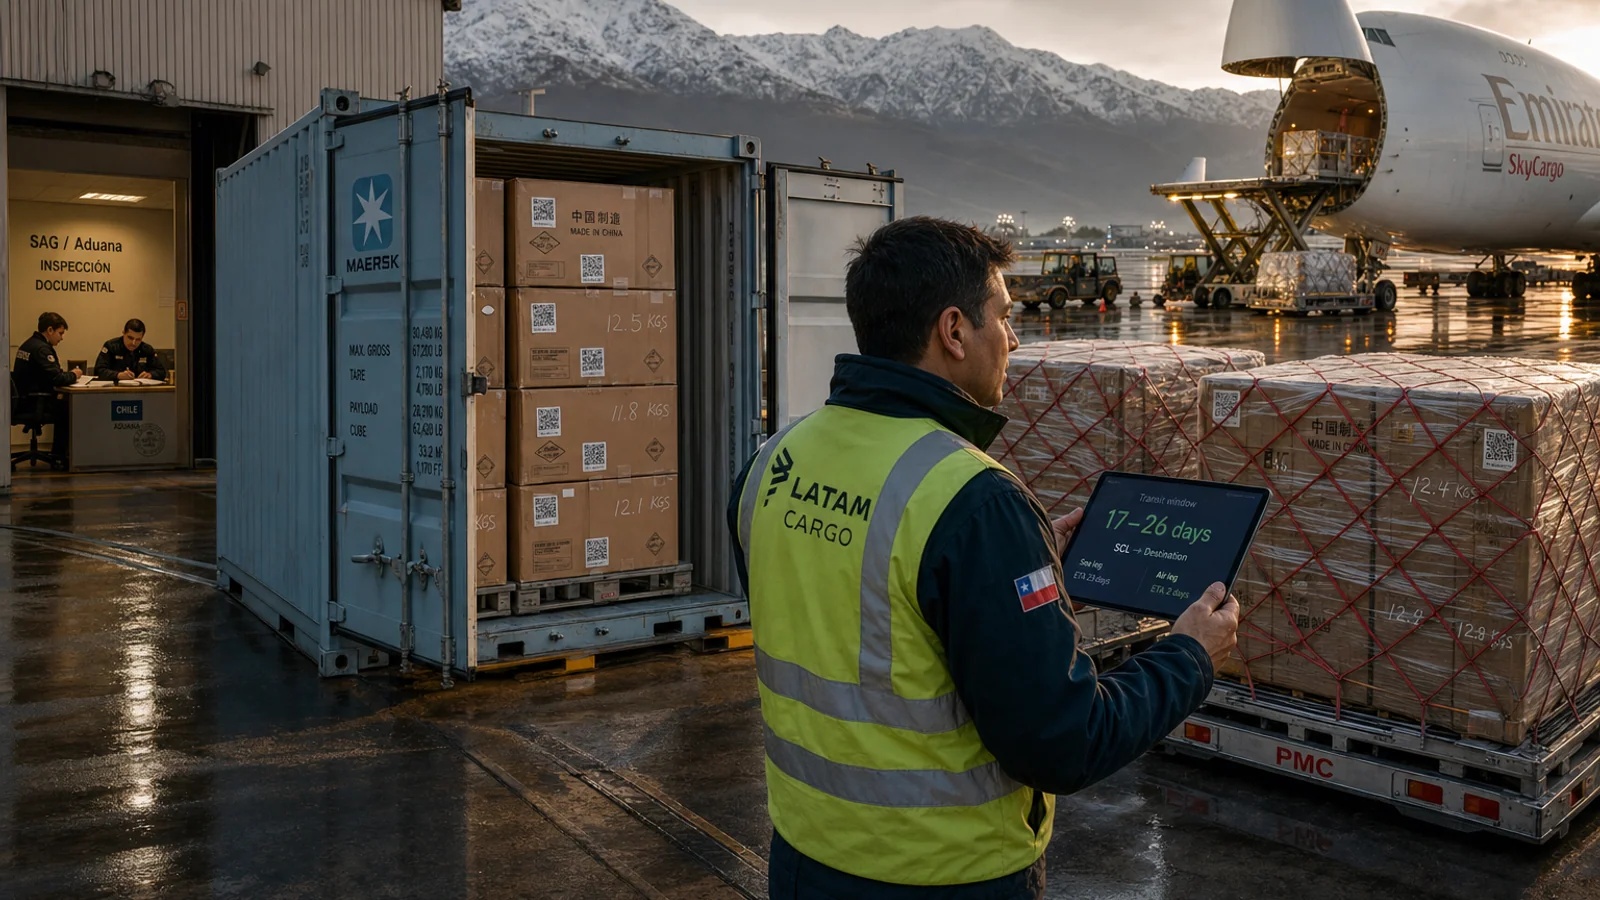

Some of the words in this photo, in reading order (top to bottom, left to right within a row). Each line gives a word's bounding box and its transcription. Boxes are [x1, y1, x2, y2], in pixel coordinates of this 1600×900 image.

[1508, 153, 1564, 182] SkyCargo
[570, 227, 591, 236] MADE
[592, 228, 600, 236] IN
[602, 228, 623, 237] CHINA
[30, 235, 59, 249] SAG
[74, 236, 123, 252] Aduana
[40, 259, 111, 274] INSPECCIÓN
[346, 254, 400, 273] MAERSK
[35, 279, 115, 293] DOCUMENTAL
[607, 313, 642, 333] 12.5
[367, 344, 391, 357] GROSS
[435, 344, 443, 357] LB
[349, 368, 366, 381] TARE
[435, 383, 443, 397] LB
[116, 405, 138, 414] CHILE
[349, 401, 378, 415] PAYLOAD
[435, 405, 443, 419] KG
[612, 402, 639, 422] 11.8
[350, 424, 367, 437] CUBE
[435, 423, 443, 437] LB
[1307, 438, 1331, 451] MADE
[1332, 441, 1342, 451] IN
[1409, 476, 1450, 503] 12.4
[790, 477, 872, 521] LATAM
[1139, 492, 1166, 506] Transit
[1167, 497, 1198, 509] window
[614, 499, 643, 517] 12.1
[784, 510, 853, 547] CARGO
[1171, 520, 1213, 546] days
[1113, 542, 1131, 554] SCL
[1143, 547, 1188, 562] Destination
[1092, 560, 1104, 571] leg
[1073, 571, 1086, 580] ETA
[1086, 573, 1095, 582] 23
[1095, 575, 1111, 586] days
[1155, 571, 1167, 580] Air
[1167, 572, 1179, 583] leg
[1165, 587, 1172, 596] 2
[1172, 588, 1190, 600] days
[1458, 622, 1486, 641] 12.8
[1276, 746, 1334, 779] PMC
